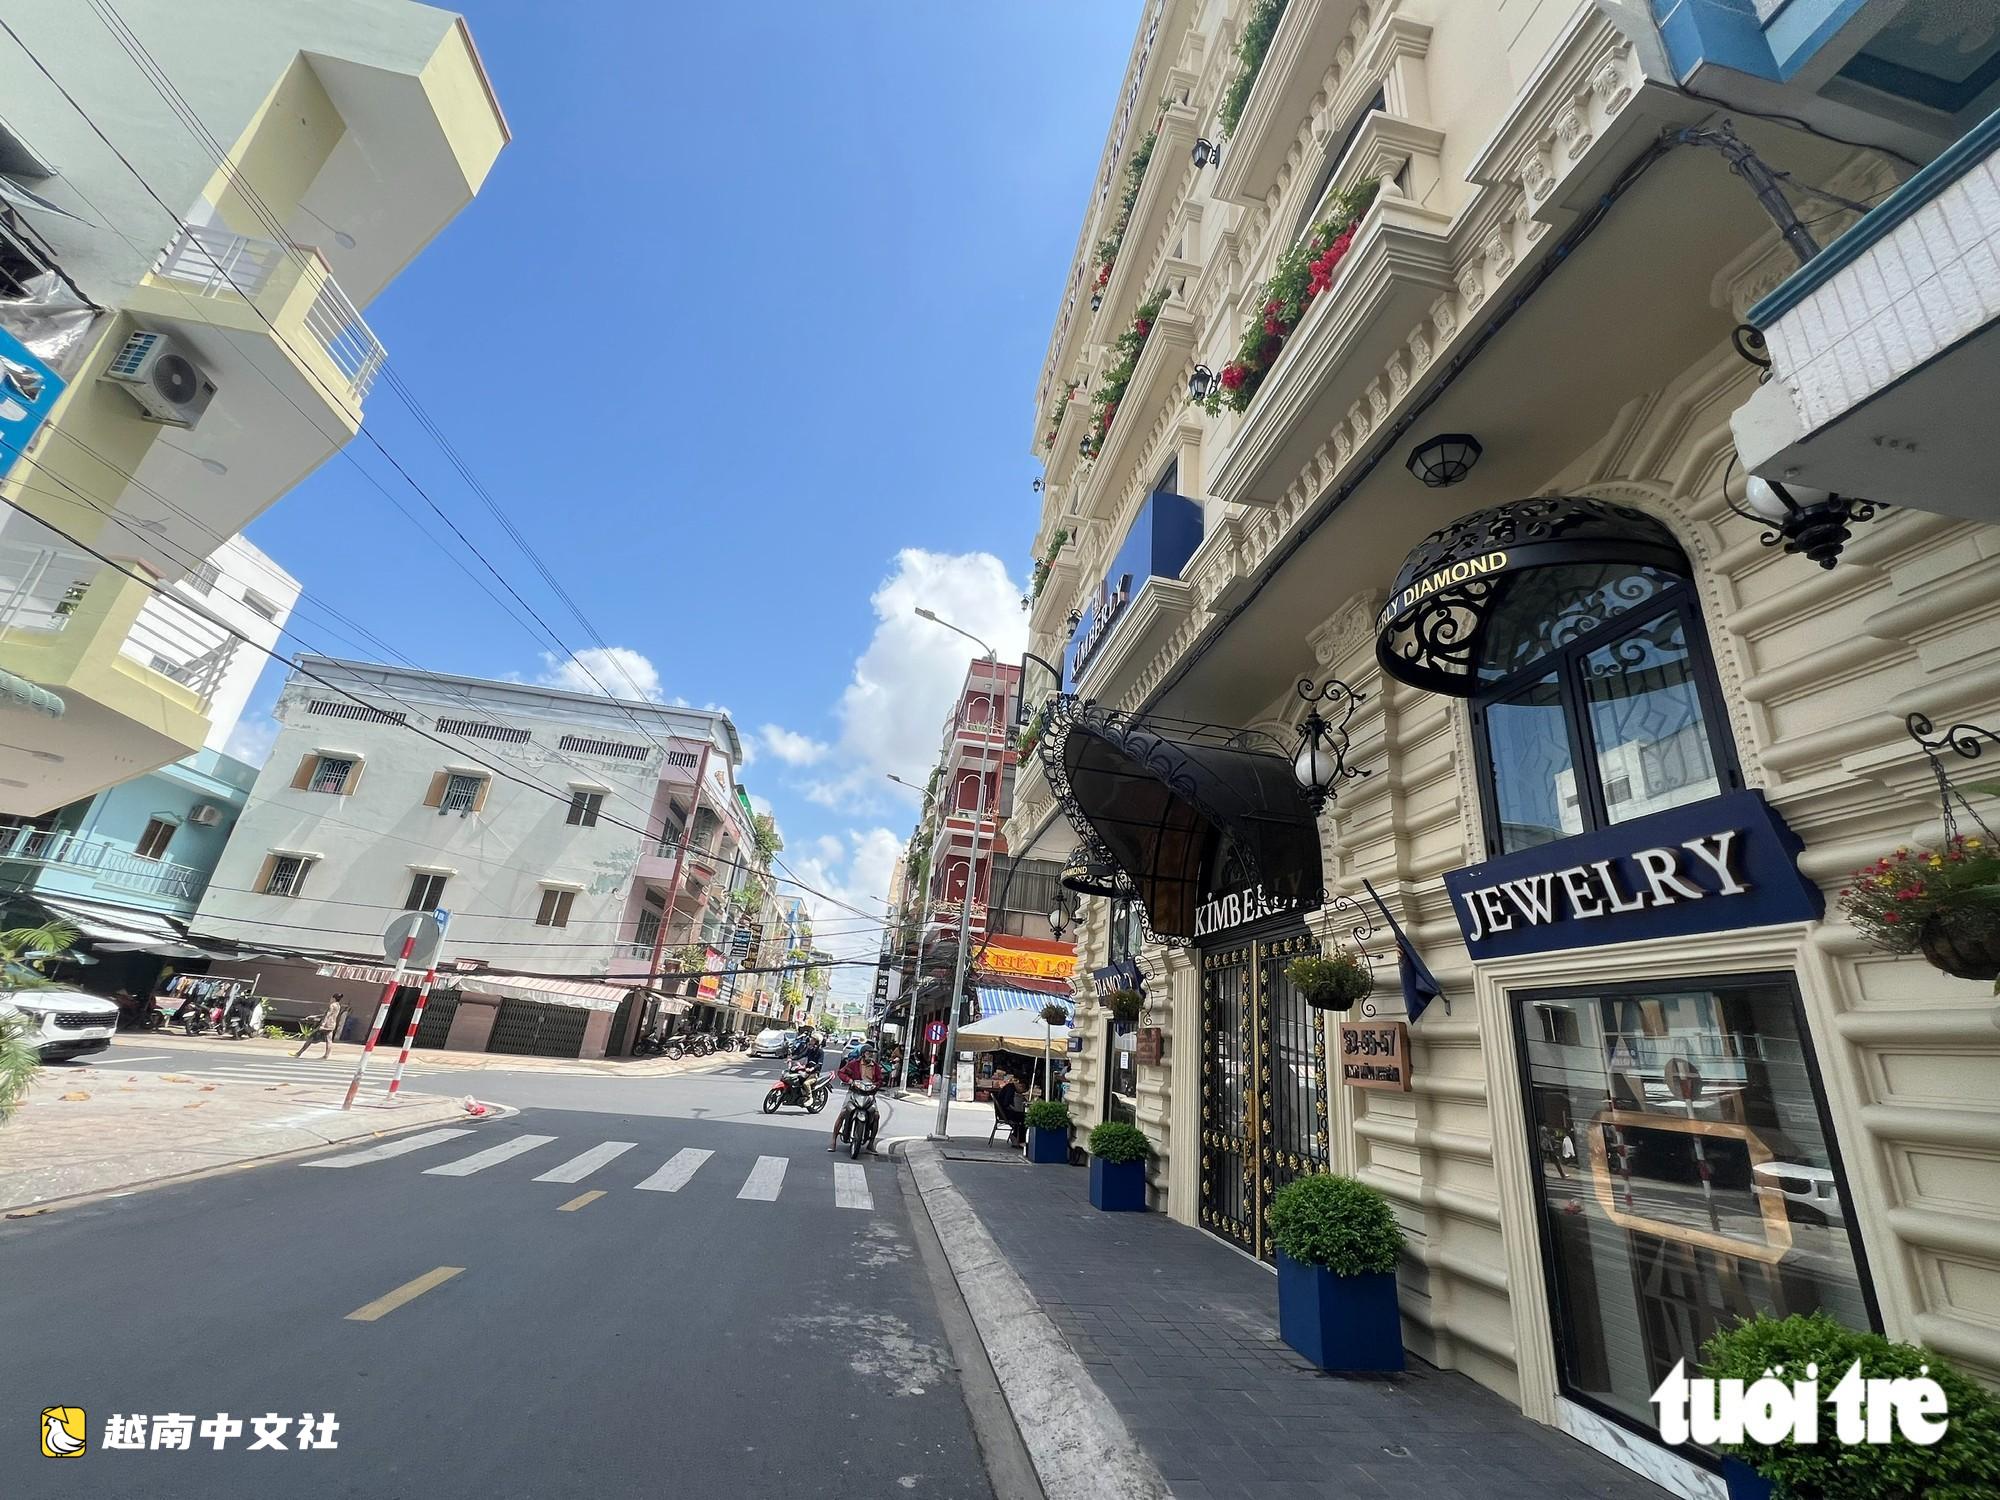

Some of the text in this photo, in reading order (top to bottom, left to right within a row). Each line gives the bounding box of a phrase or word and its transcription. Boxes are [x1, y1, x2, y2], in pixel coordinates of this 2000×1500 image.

[1403, 551, 1507, 607] DIAMOND
[1461, 830, 1746, 942] JEWELRY
[1094, 972, 1133, 998] DIAMOD
